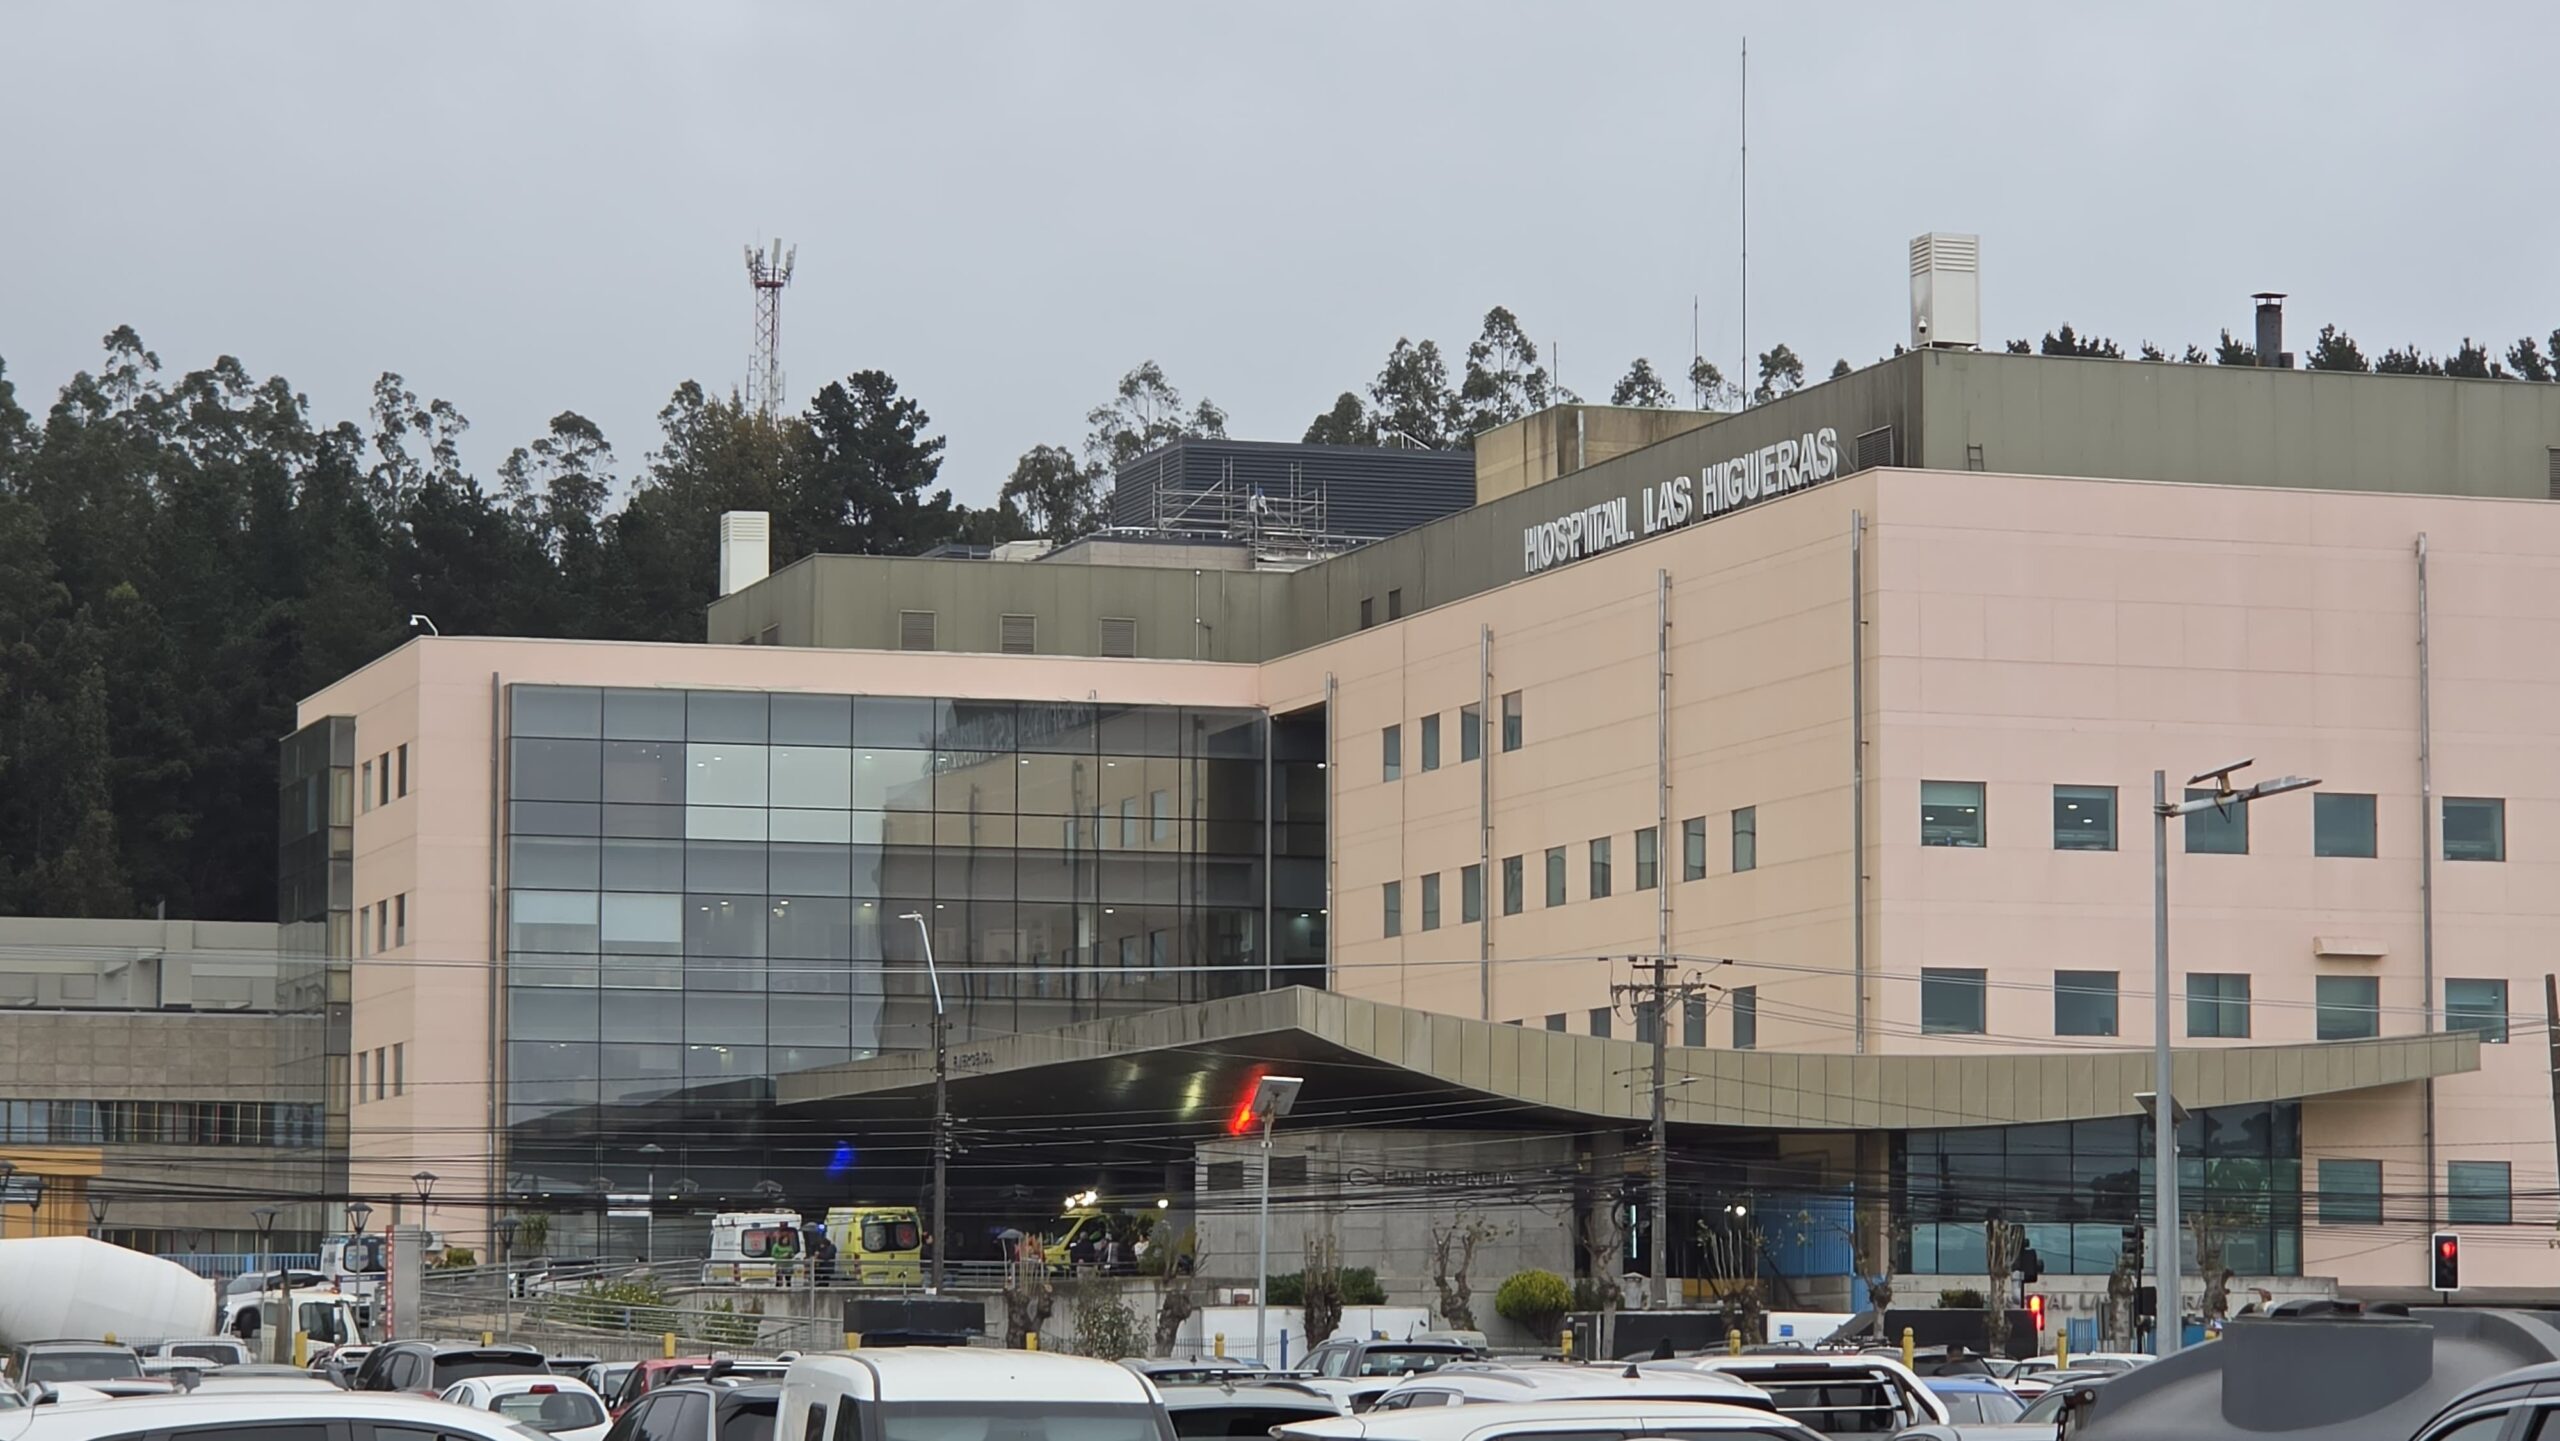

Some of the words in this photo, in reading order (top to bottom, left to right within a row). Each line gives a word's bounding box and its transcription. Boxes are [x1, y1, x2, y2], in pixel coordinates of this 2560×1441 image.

[1524, 497, 1634, 573] HOSPITAL
[1643, 476, 1692, 534] LAS
[1702, 428, 1837, 515] HIGUERAS
